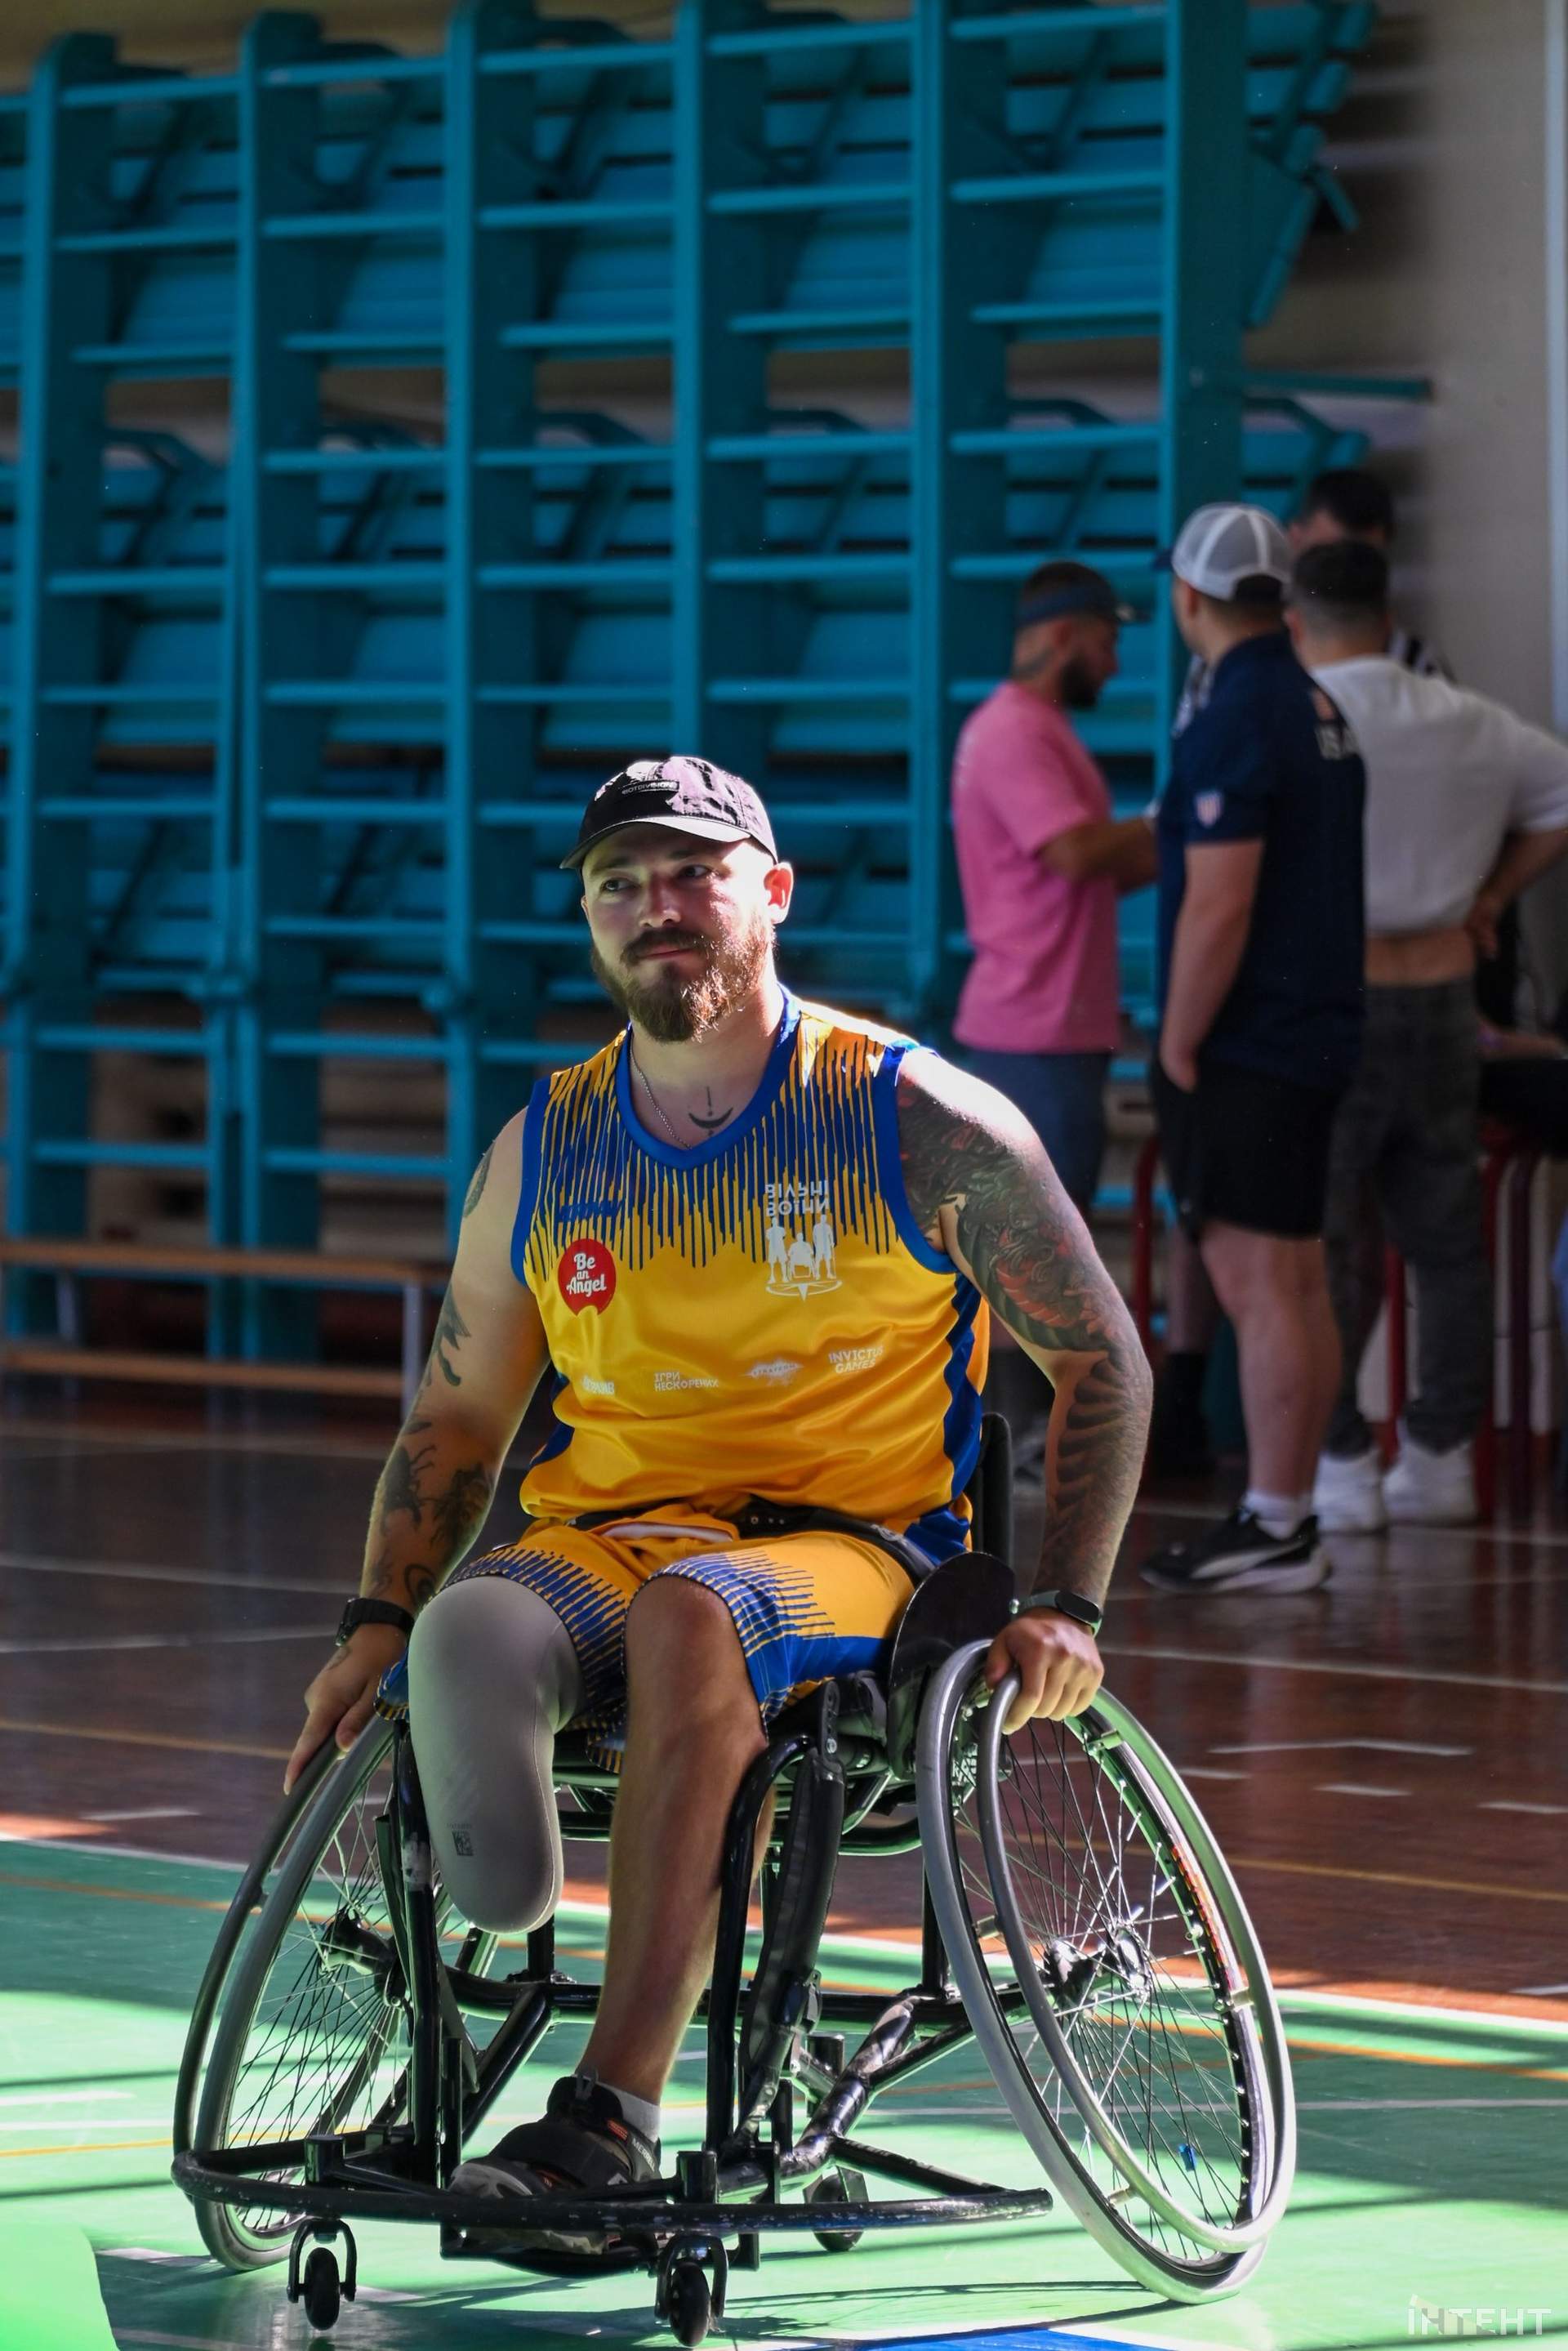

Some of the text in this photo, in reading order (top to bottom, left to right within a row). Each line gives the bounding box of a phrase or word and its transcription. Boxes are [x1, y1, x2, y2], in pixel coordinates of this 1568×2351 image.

[574, 1252, 595, 1270] Be
[577, 1269, 590, 1281] an
[566, 1274, 607, 1297] Angel
[828, 1345, 884, 1363] INVICTUS
[835, 1358, 876, 1374] GAMES
[655, 1372, 680, 1382] ІГРИ
